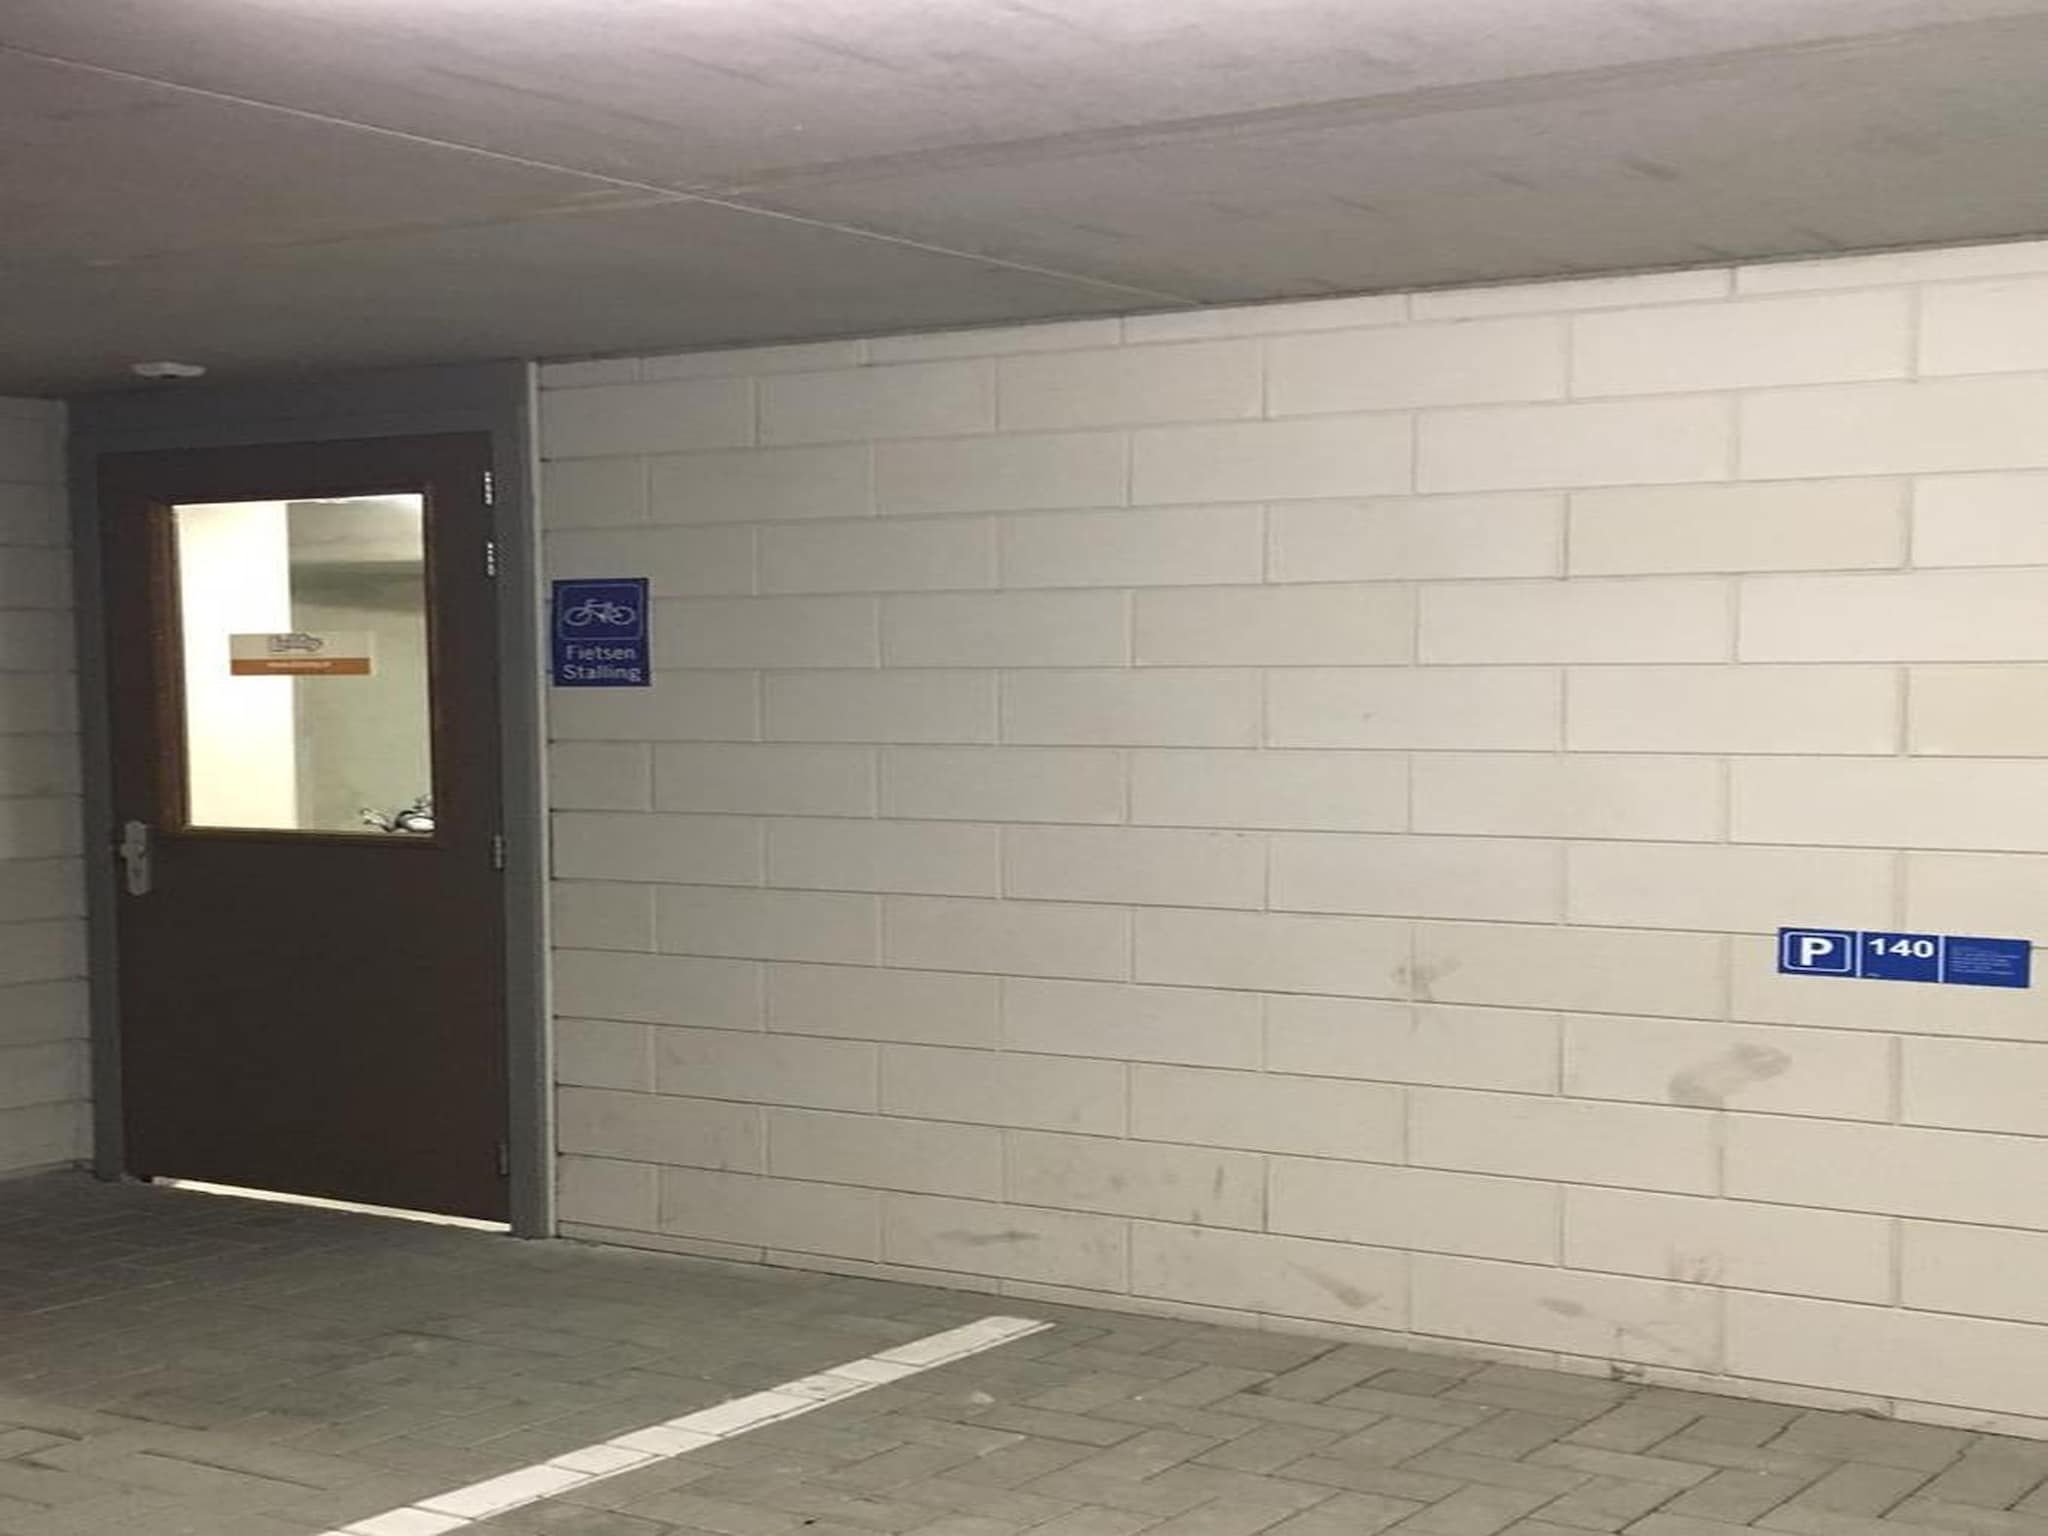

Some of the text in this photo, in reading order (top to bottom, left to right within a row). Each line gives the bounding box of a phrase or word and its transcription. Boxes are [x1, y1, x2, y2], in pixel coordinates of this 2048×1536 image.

[566, 644, 636, 660] Fietsen
[563, 663, 641, 682] Stalling
[1800, 937, 1934, 967] P 140
